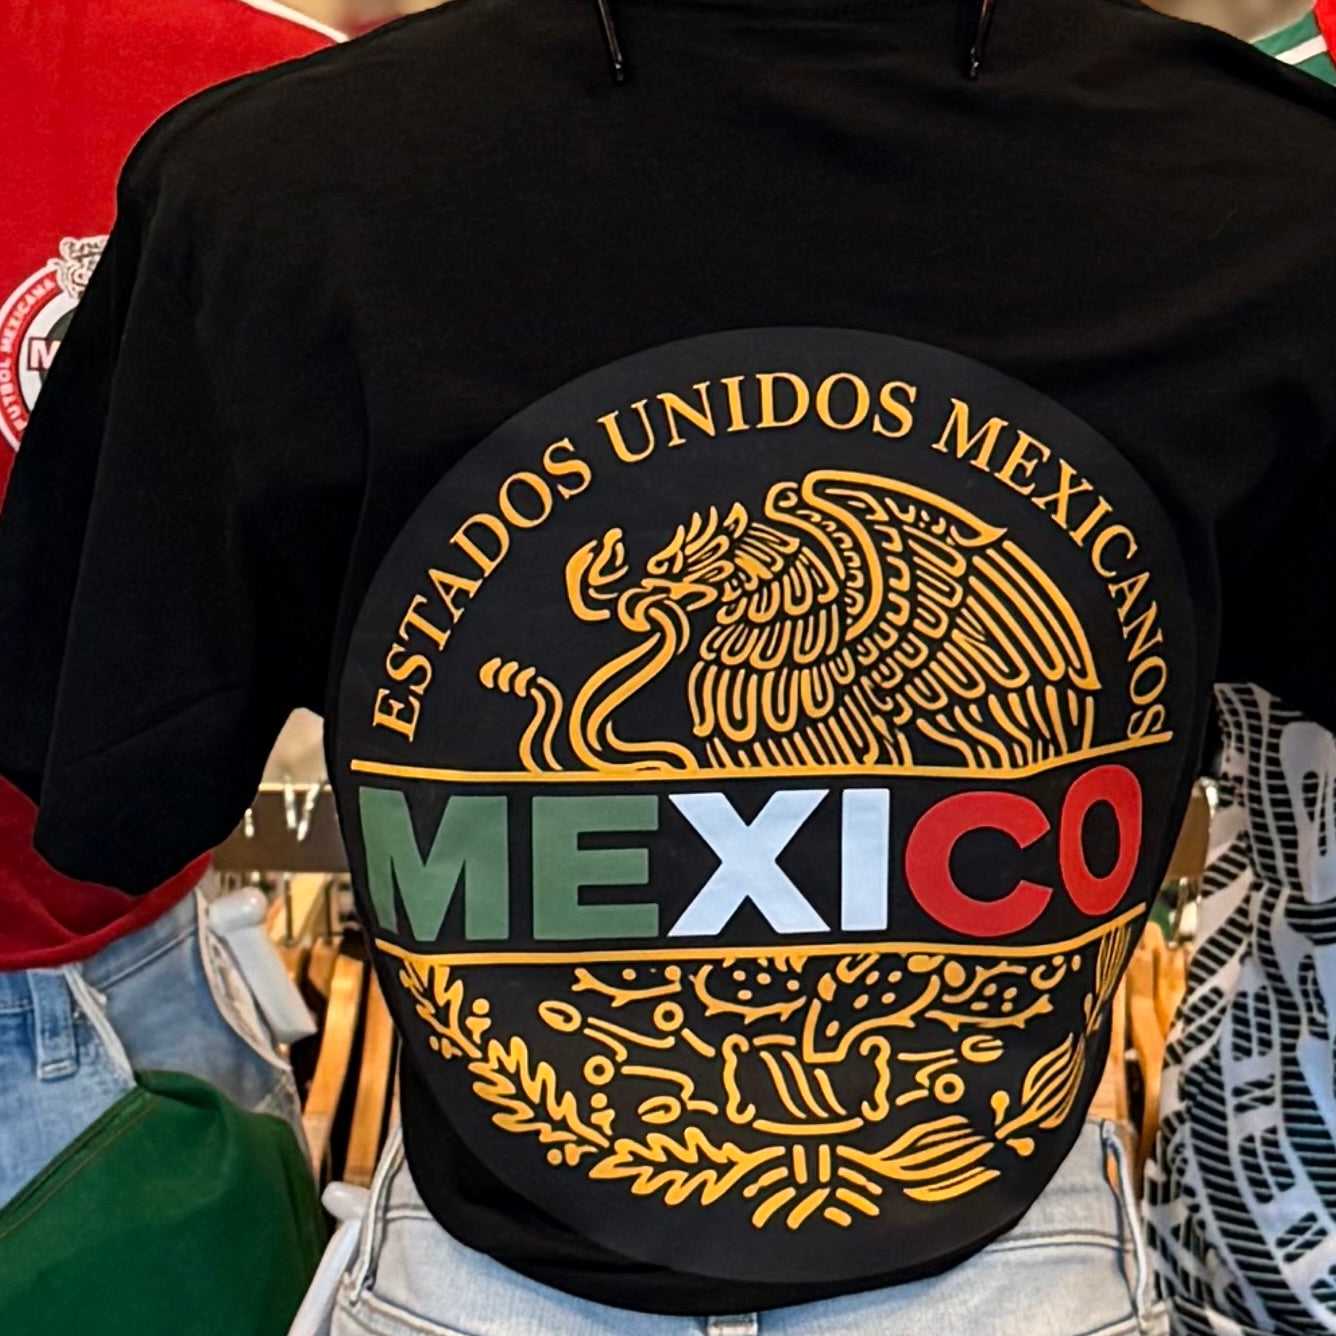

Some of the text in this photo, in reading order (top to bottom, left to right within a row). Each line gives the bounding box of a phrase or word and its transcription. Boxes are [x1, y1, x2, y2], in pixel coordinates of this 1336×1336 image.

[372, 371, 1174, 742] ESTADOS UNIDOS MEXICANOS
[358, 764, 1143, 942] MEXICO
